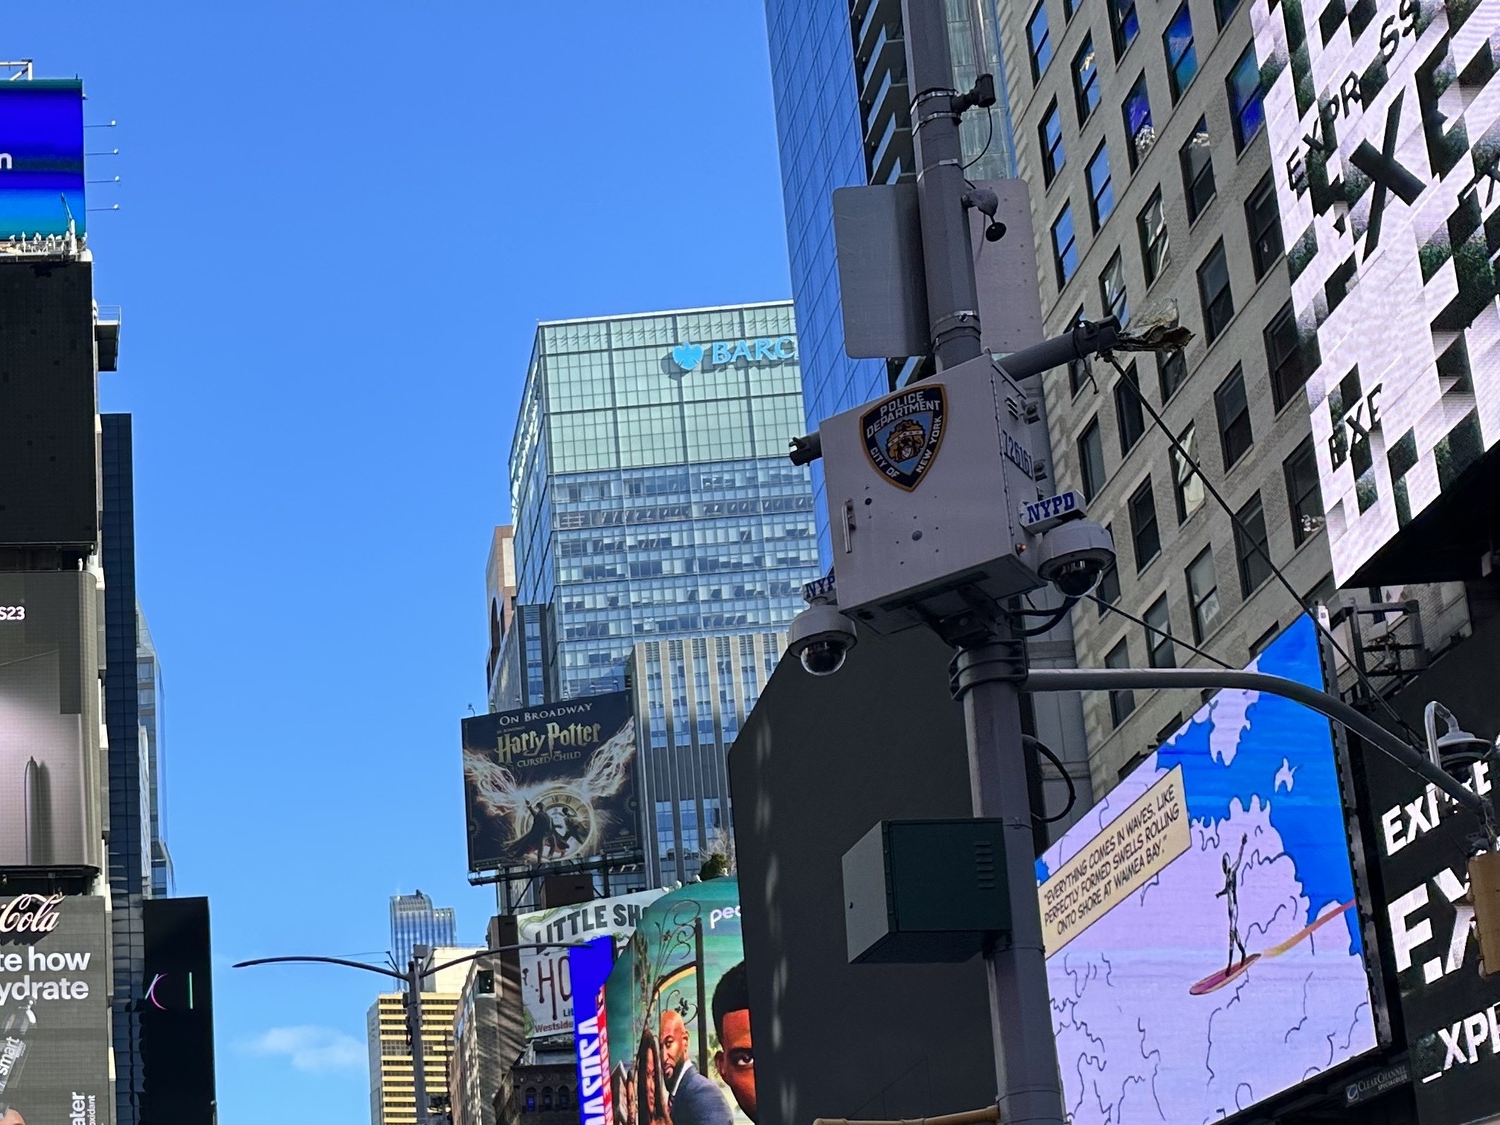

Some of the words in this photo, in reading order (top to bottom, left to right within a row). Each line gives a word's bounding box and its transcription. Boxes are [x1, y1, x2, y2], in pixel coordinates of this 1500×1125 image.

[712, 336, 798, 364] BARC
[866, 400, 941, 438] DEPARTMENT
[880, 391, 925, 417] POLICE
[915, 452, 931, 474] NEW
[929, 415, 942, 446] YORK
[870, 446, 887, 469] CITY
[886, 466, 900, 479] OF
[1027, 492, 1075, 524] NYPD
[805, 575, 836, 598] NYP
[499, 714, 519, 726] ON
[524, 703, 593, 723] BROADWAY
[494, 730, 546, 765] Harry
[546, 722, 601, 759] Potter
[517, 756, 550, 768] CURSED
[552, 751, 582, 762] CHILD
[1089, 835, 1116, 867] COMES
[1117, 827, 1125, 846] IN
[1156, 784, 1175, 811] LIKE
[1044, 886, 1080, 927] PERFECTLY
[1081, 861, 1111, 897] FORMED
[1113, 836, 1144, 870] SWELLS
[1145, 802, 1180, 841] ROLLING
[1057, 909, 1078, 935] ONTO
[1077, 891, 1103, 920] SHORE
[1103, 880, 1112, 899] AT
[1113, 857, 1146, 889] WAIMEA
[534, 905, 608, 955] LITTLE
[28, 946, 91, 972] how
